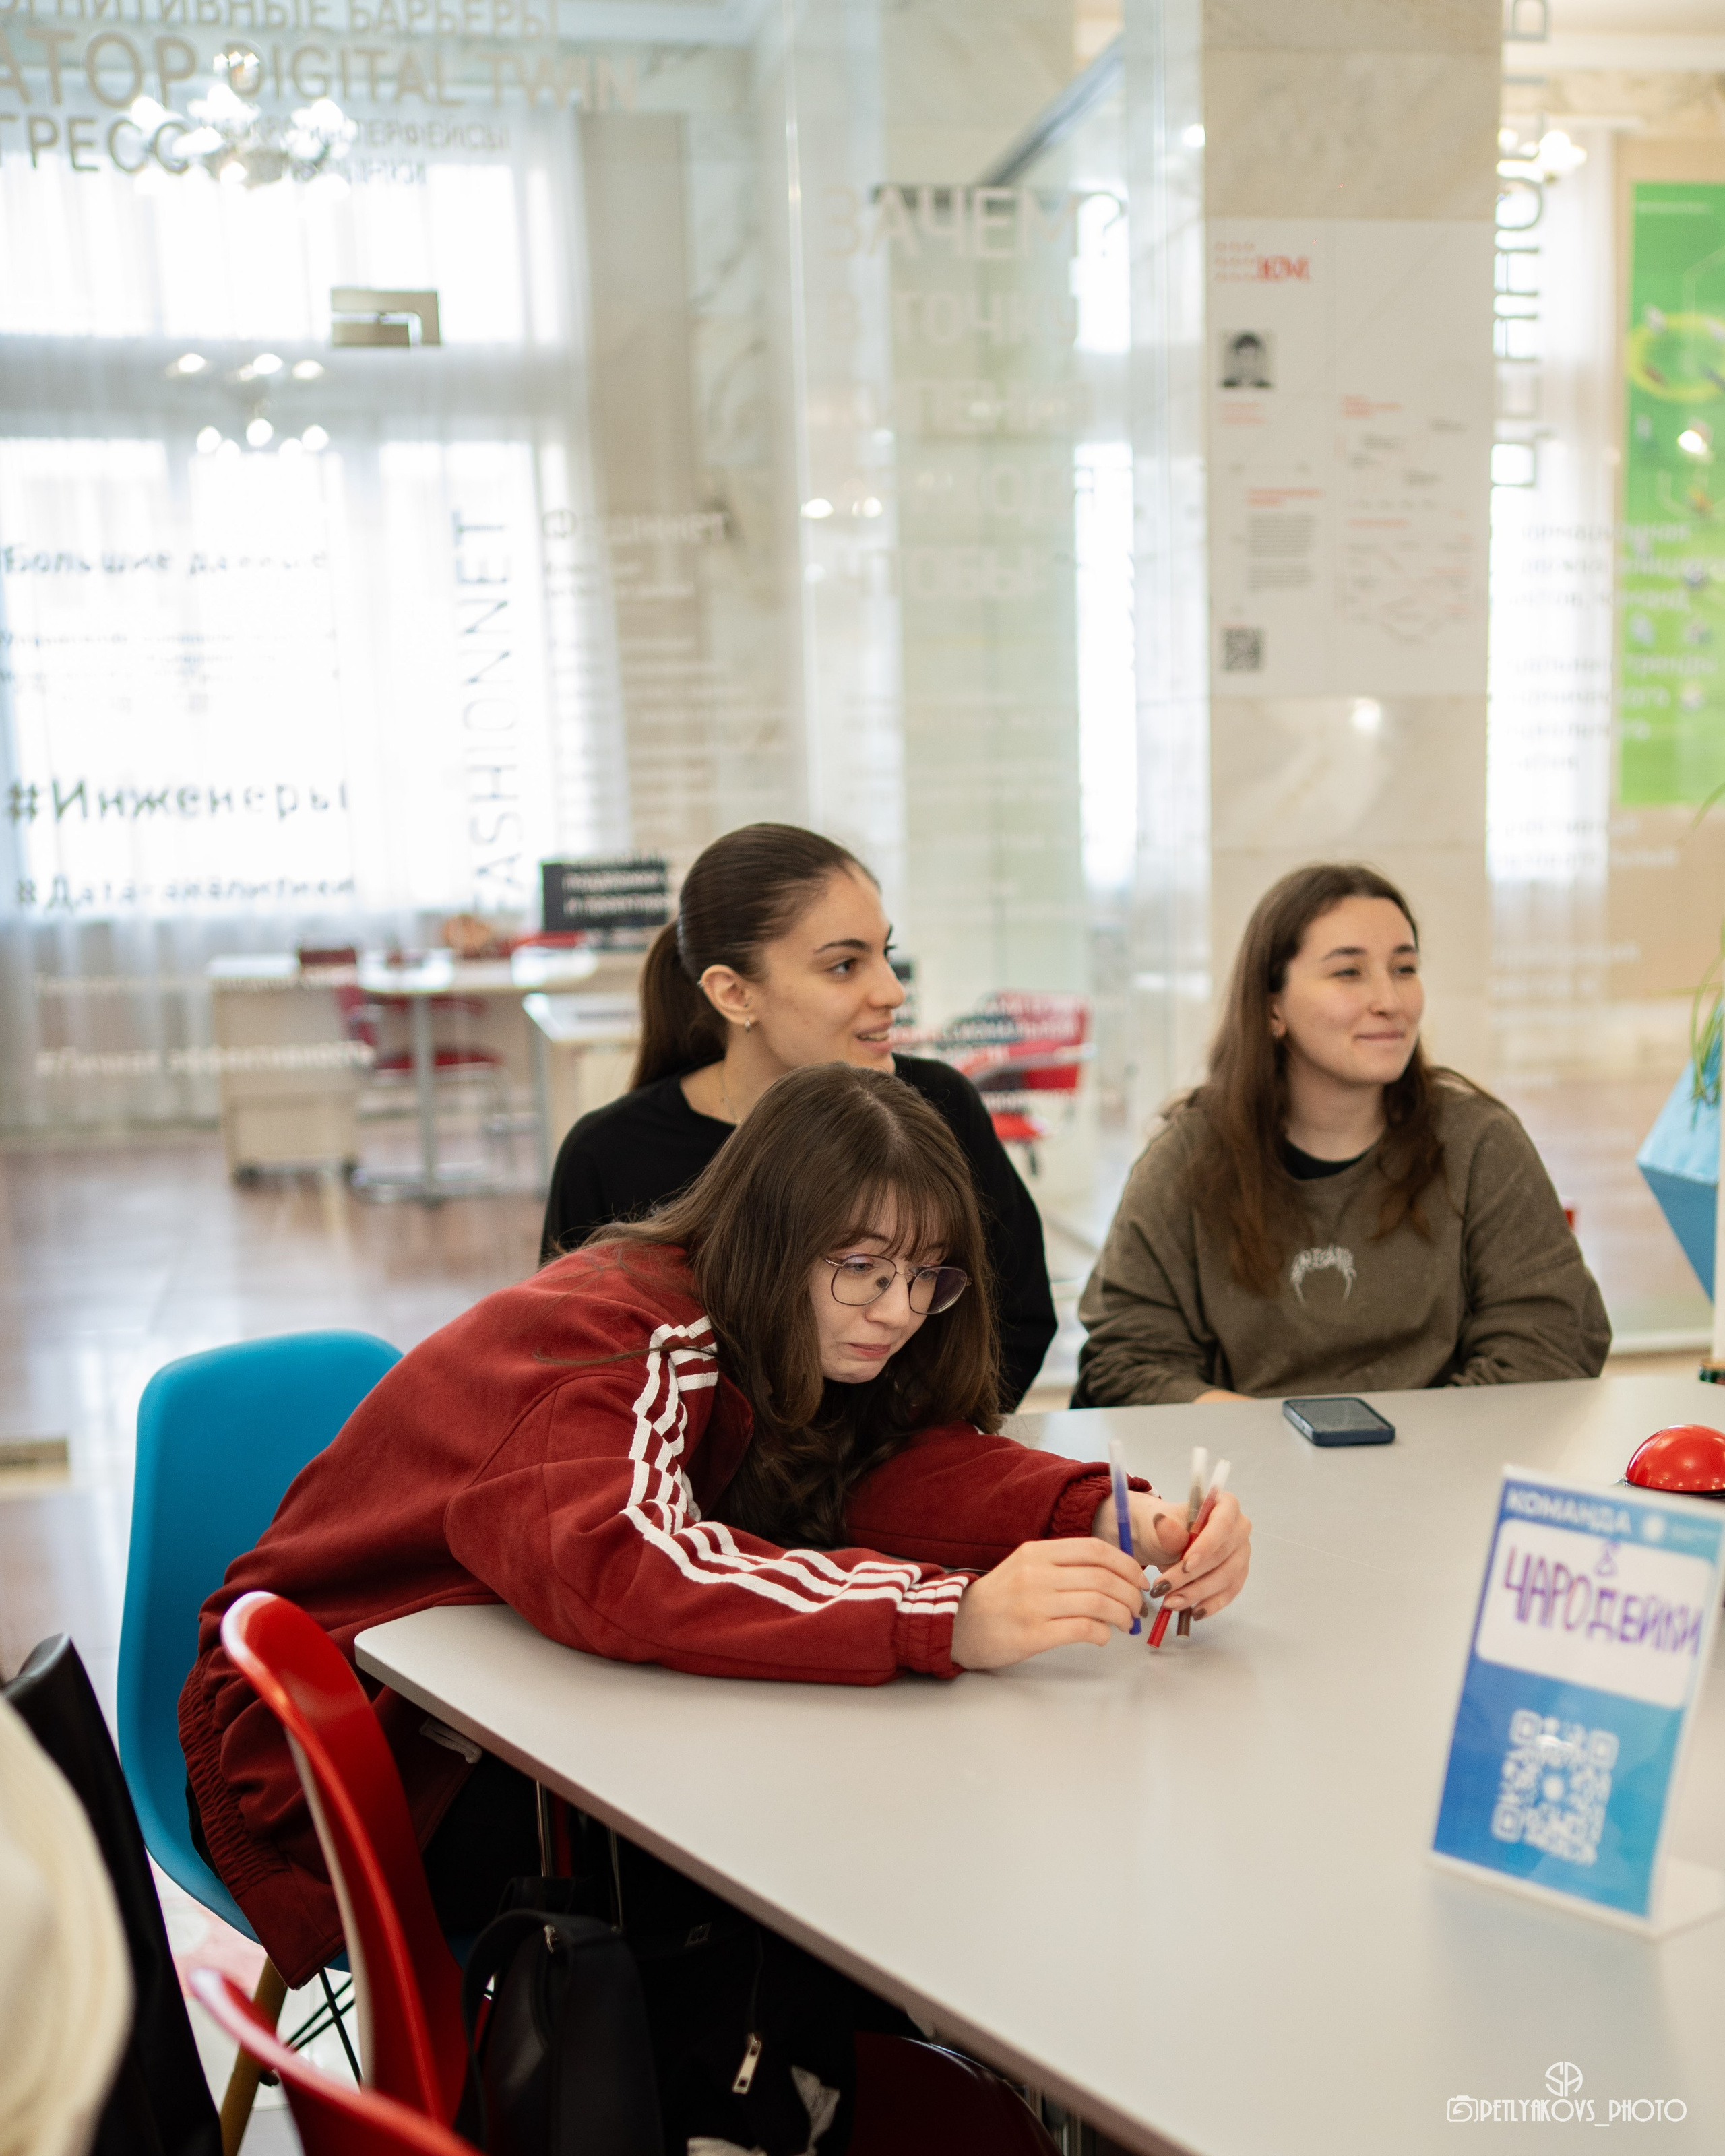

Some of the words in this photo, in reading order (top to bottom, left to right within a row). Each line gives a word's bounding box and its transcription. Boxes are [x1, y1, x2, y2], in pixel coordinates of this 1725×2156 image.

[344, 0, 559, 42] БАРЬЕРЫ
[224, 41, 464, 107] DIGITAL
[476, 53, 639, 112] TWIN
[823, 184, 1127, 259] ЗАЧЕМ?
[8, 776, 349, 823] #Инженеры
[1503, 1486, 1632, 1535] КОМАНДА
